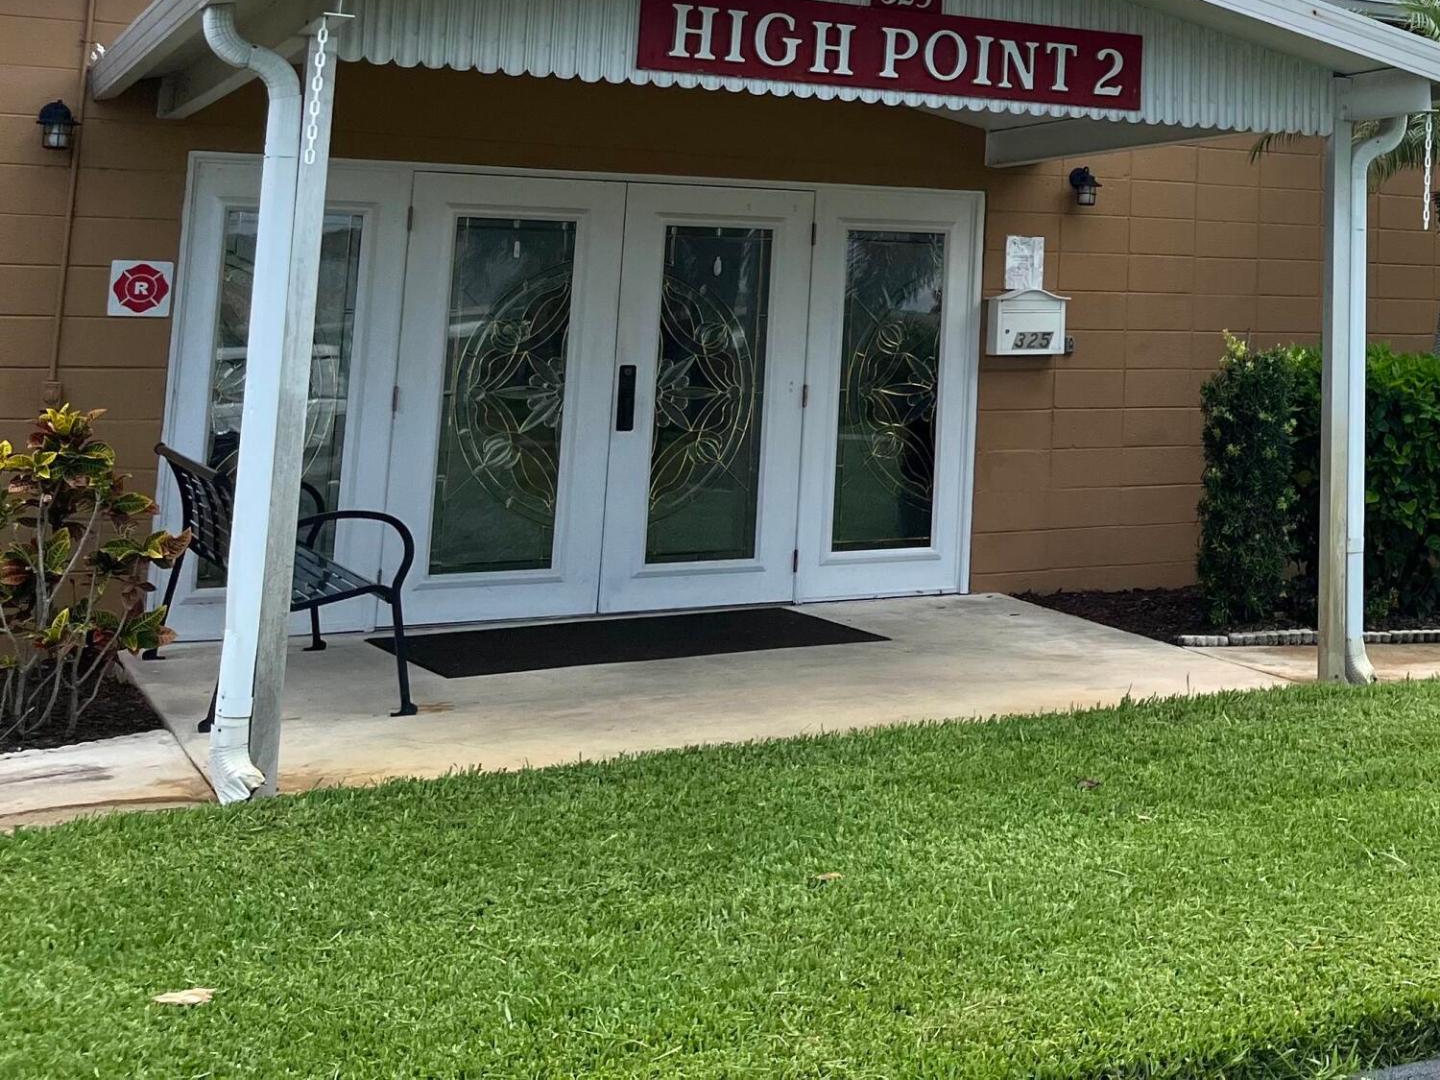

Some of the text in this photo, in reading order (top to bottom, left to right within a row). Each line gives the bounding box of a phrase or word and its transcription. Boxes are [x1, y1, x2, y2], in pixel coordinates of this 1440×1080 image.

[667, 3, 1124, 96] HIGH POINT 2
[134, 281, 149, 295] R
[1014, 332, 1052, 349] 325
